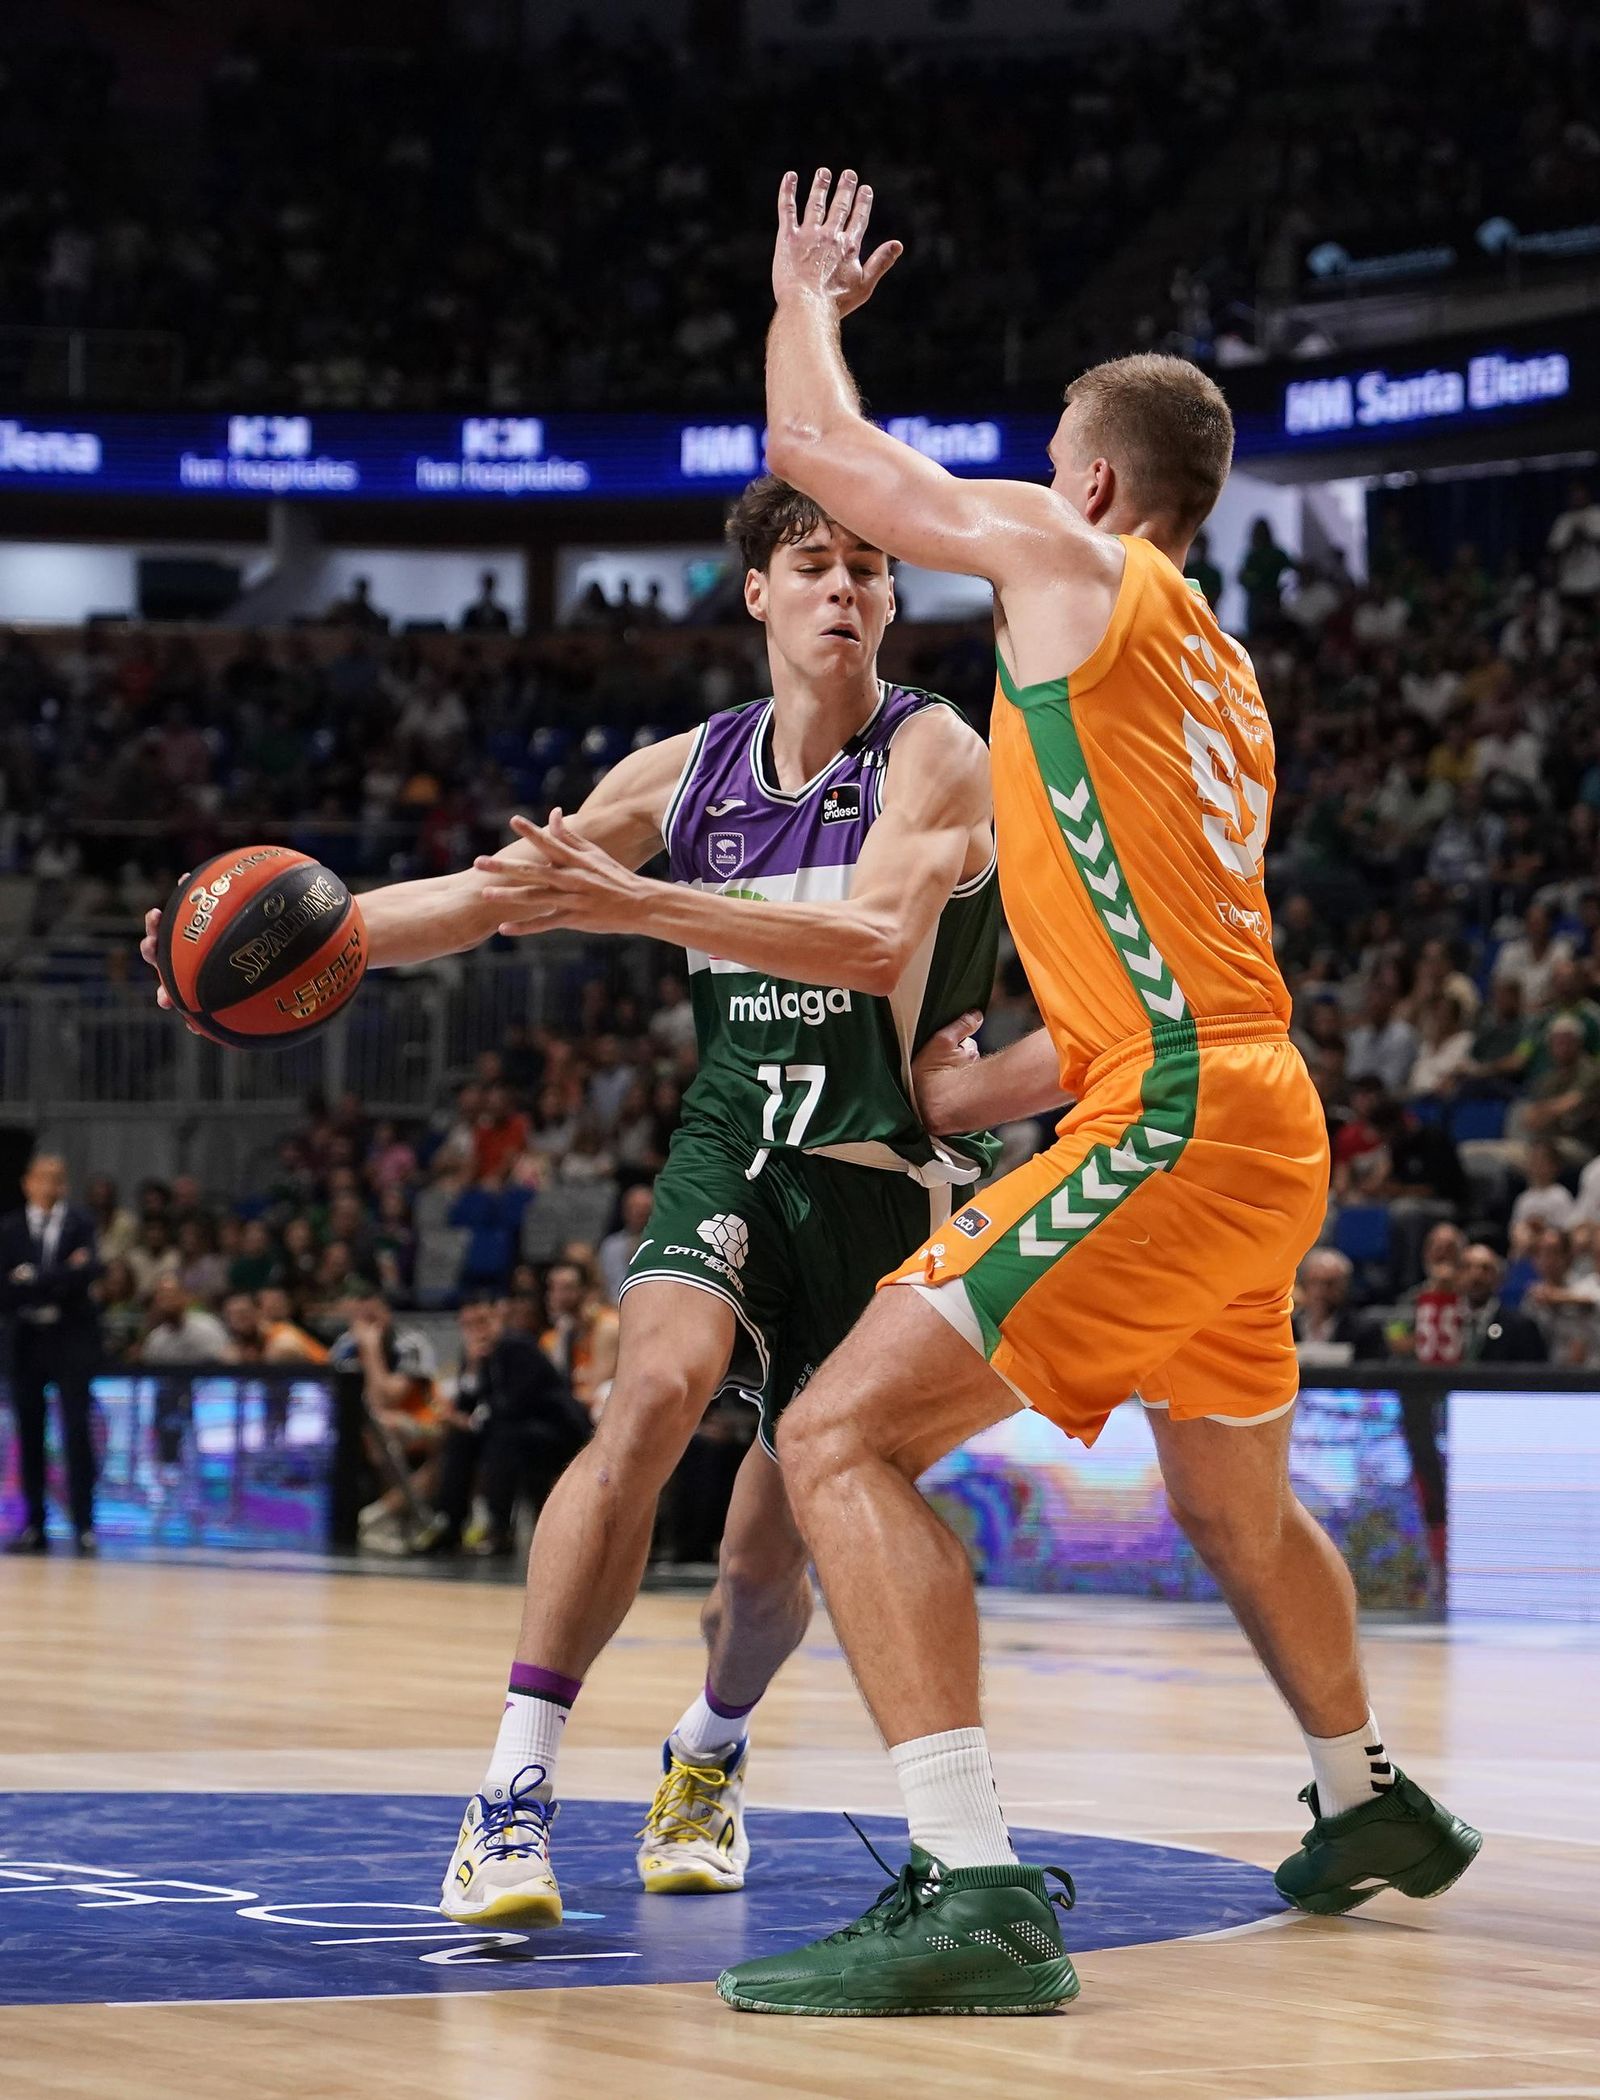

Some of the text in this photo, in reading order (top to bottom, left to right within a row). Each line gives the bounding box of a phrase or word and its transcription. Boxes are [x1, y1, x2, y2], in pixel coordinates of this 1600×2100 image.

[1285, 354, 1570, 434] HM Santa Elena
[0, 420, 99, 473] lena
[681, 426, 757, 476] HM
[824, 806, 859, 820] endesa
[210, 849, 281, 897] endes
[229, 875, 345, 984] SPALDING
[274, 926, 361, 1015] LEGACY
[729, 982, 852, 1026] málaga
[757, 1064, 826, 1146] 17
[956, 1216, 975, 1231] acb
